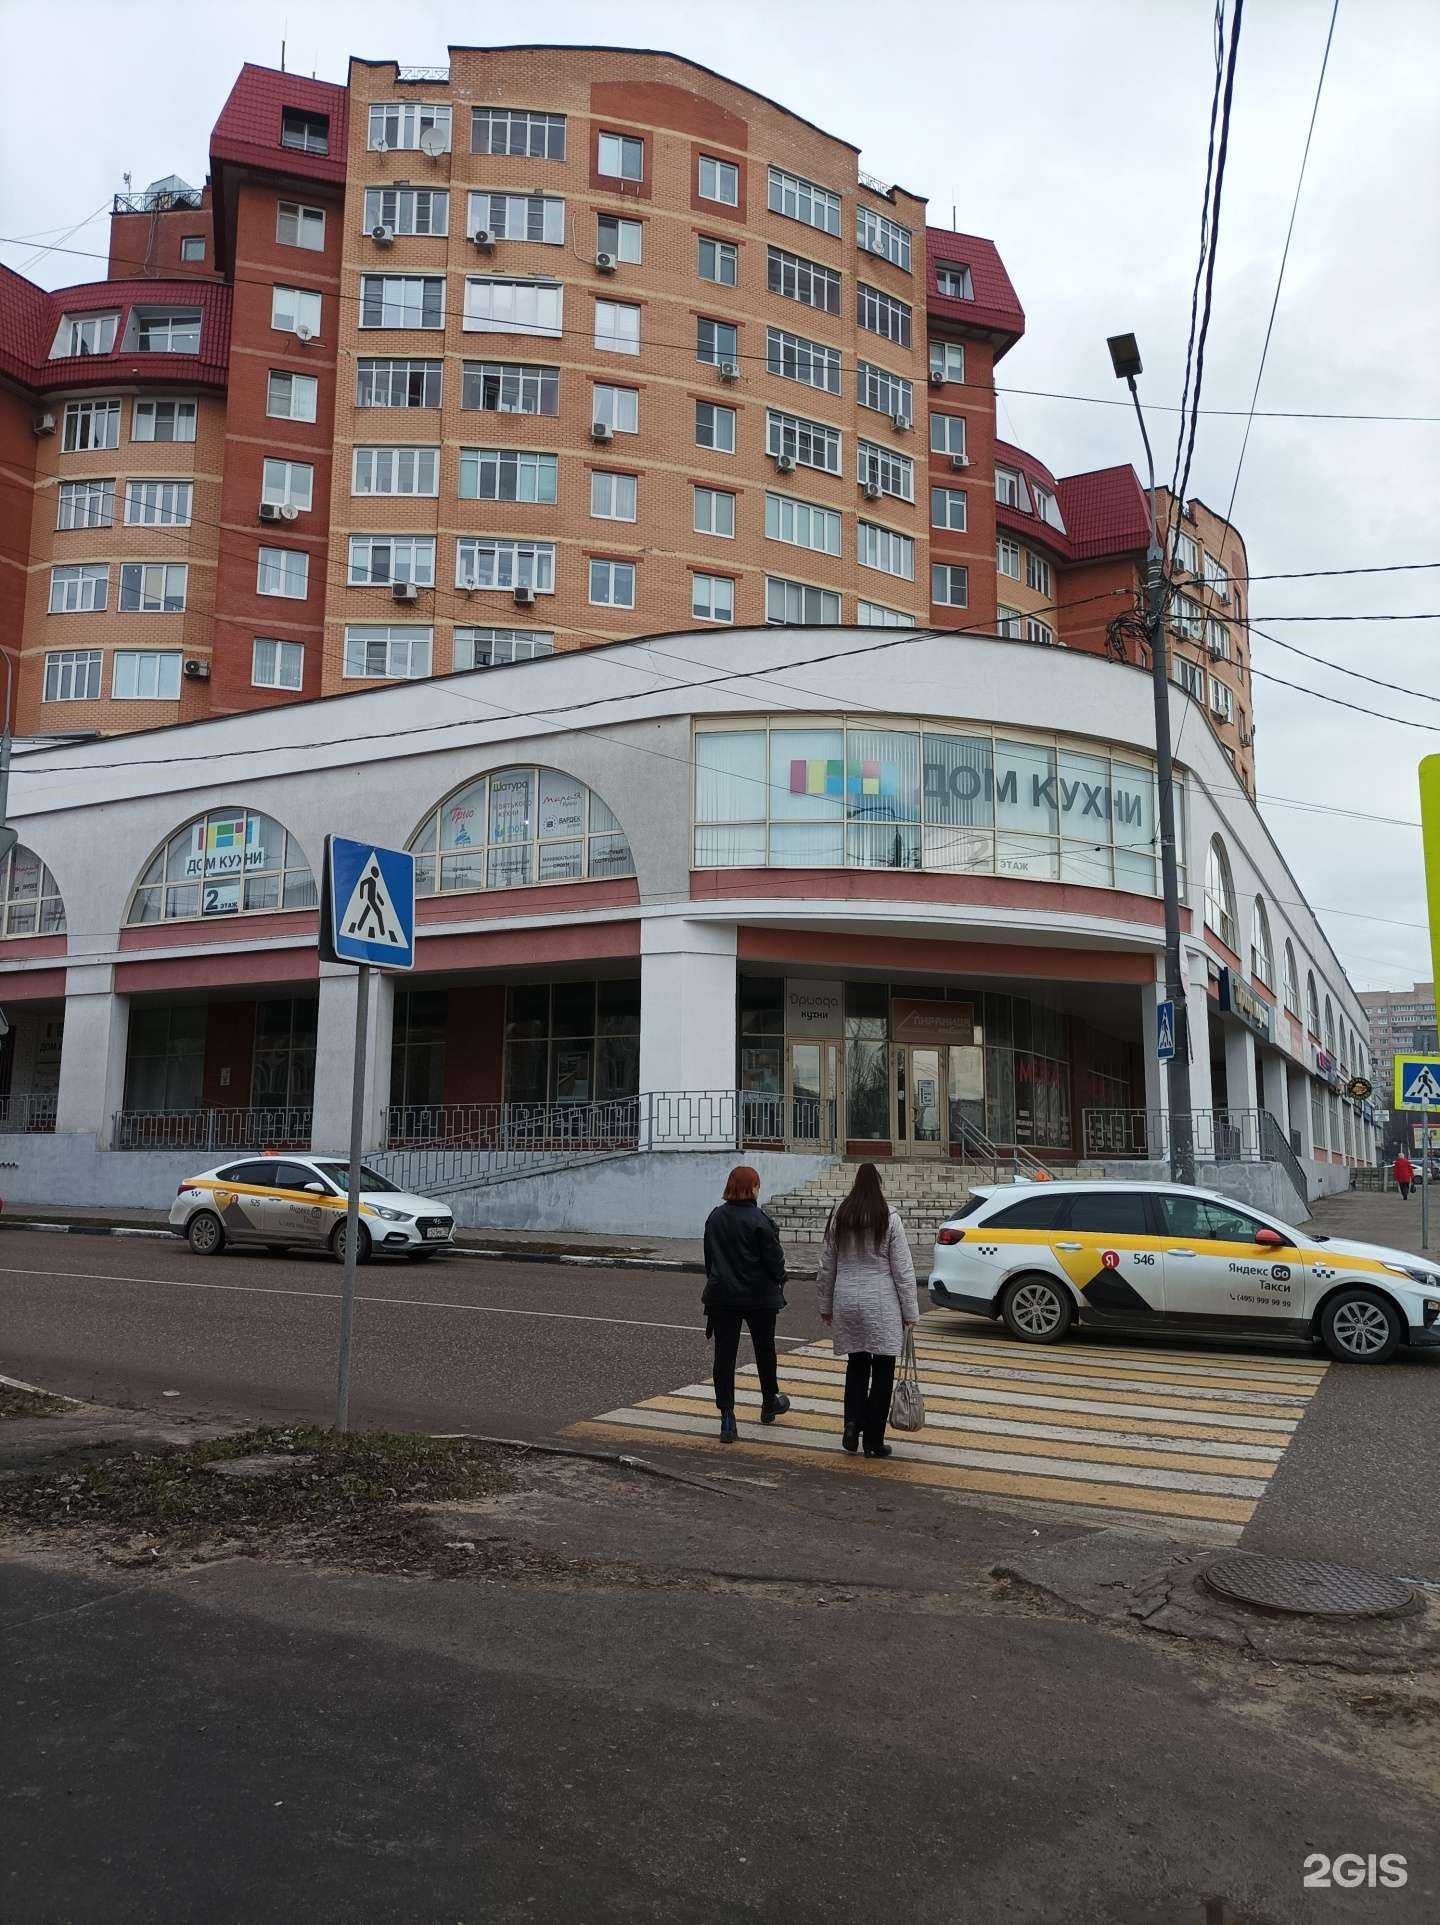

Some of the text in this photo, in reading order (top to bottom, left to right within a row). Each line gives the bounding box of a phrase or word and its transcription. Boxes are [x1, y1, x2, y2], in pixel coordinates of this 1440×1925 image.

[493, 781, 528, 793] Шатура
[923, 763, 1142, 828] ДОМ КУХНИ
[187, 852, 262, 875] ДОМ КУХНИ
[206, 889, 219, 911] 2
[1133, 1253, 1155, 1266] 546
[1228, 1262, 1289, 1279] Яндекс Go
[1259, 1280, 1291, 1292] Такси
